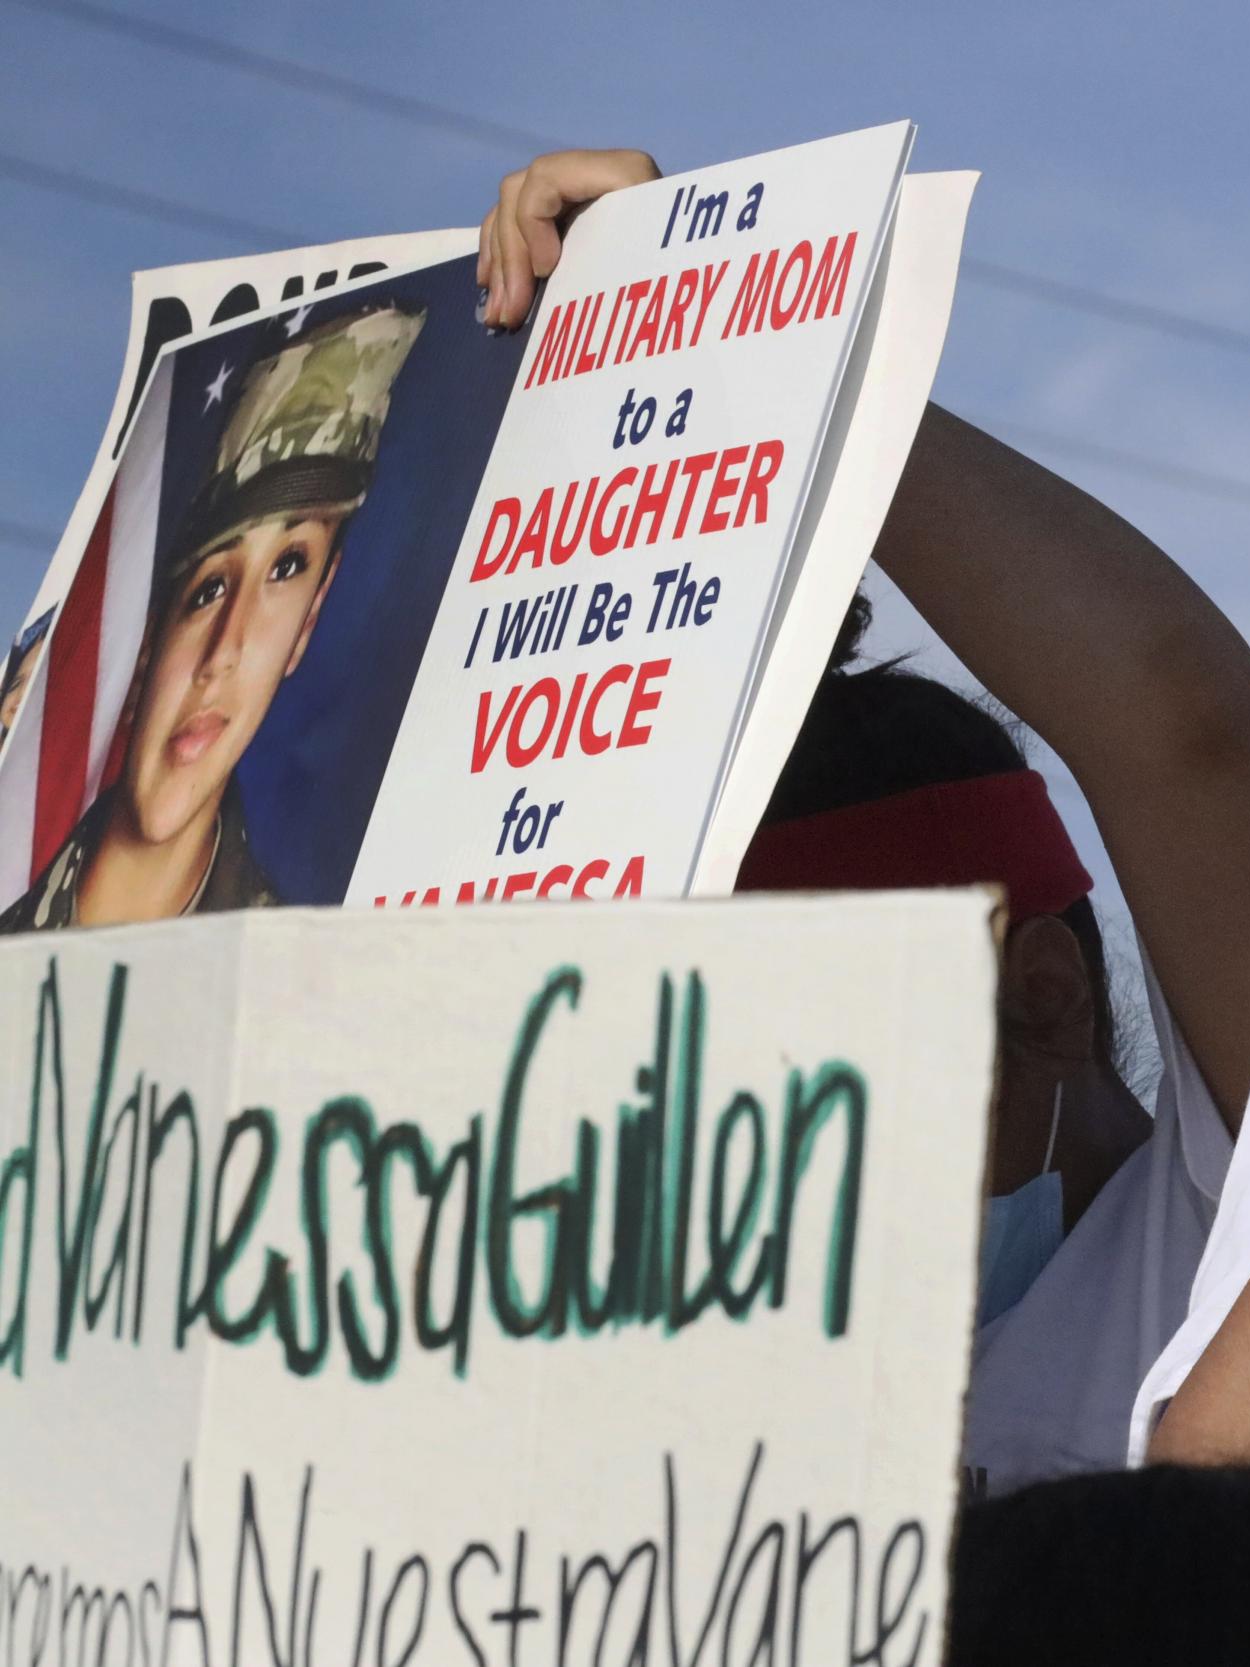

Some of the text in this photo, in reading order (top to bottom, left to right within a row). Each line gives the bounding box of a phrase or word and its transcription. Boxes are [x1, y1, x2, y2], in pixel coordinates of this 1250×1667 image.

[661, 183, 764, 248] I'm a
[524, 261, 728, 390] MILITARY
[721, 232, 857, 340] MOM
[613, 388, 692, 449] to a
[470, 440, 785, 582] DAUGHTER
[464, 562, 720, 668] I Will Be The
[470, 659, 671, 773] VOICE
[496, 787, 564, 856] for
